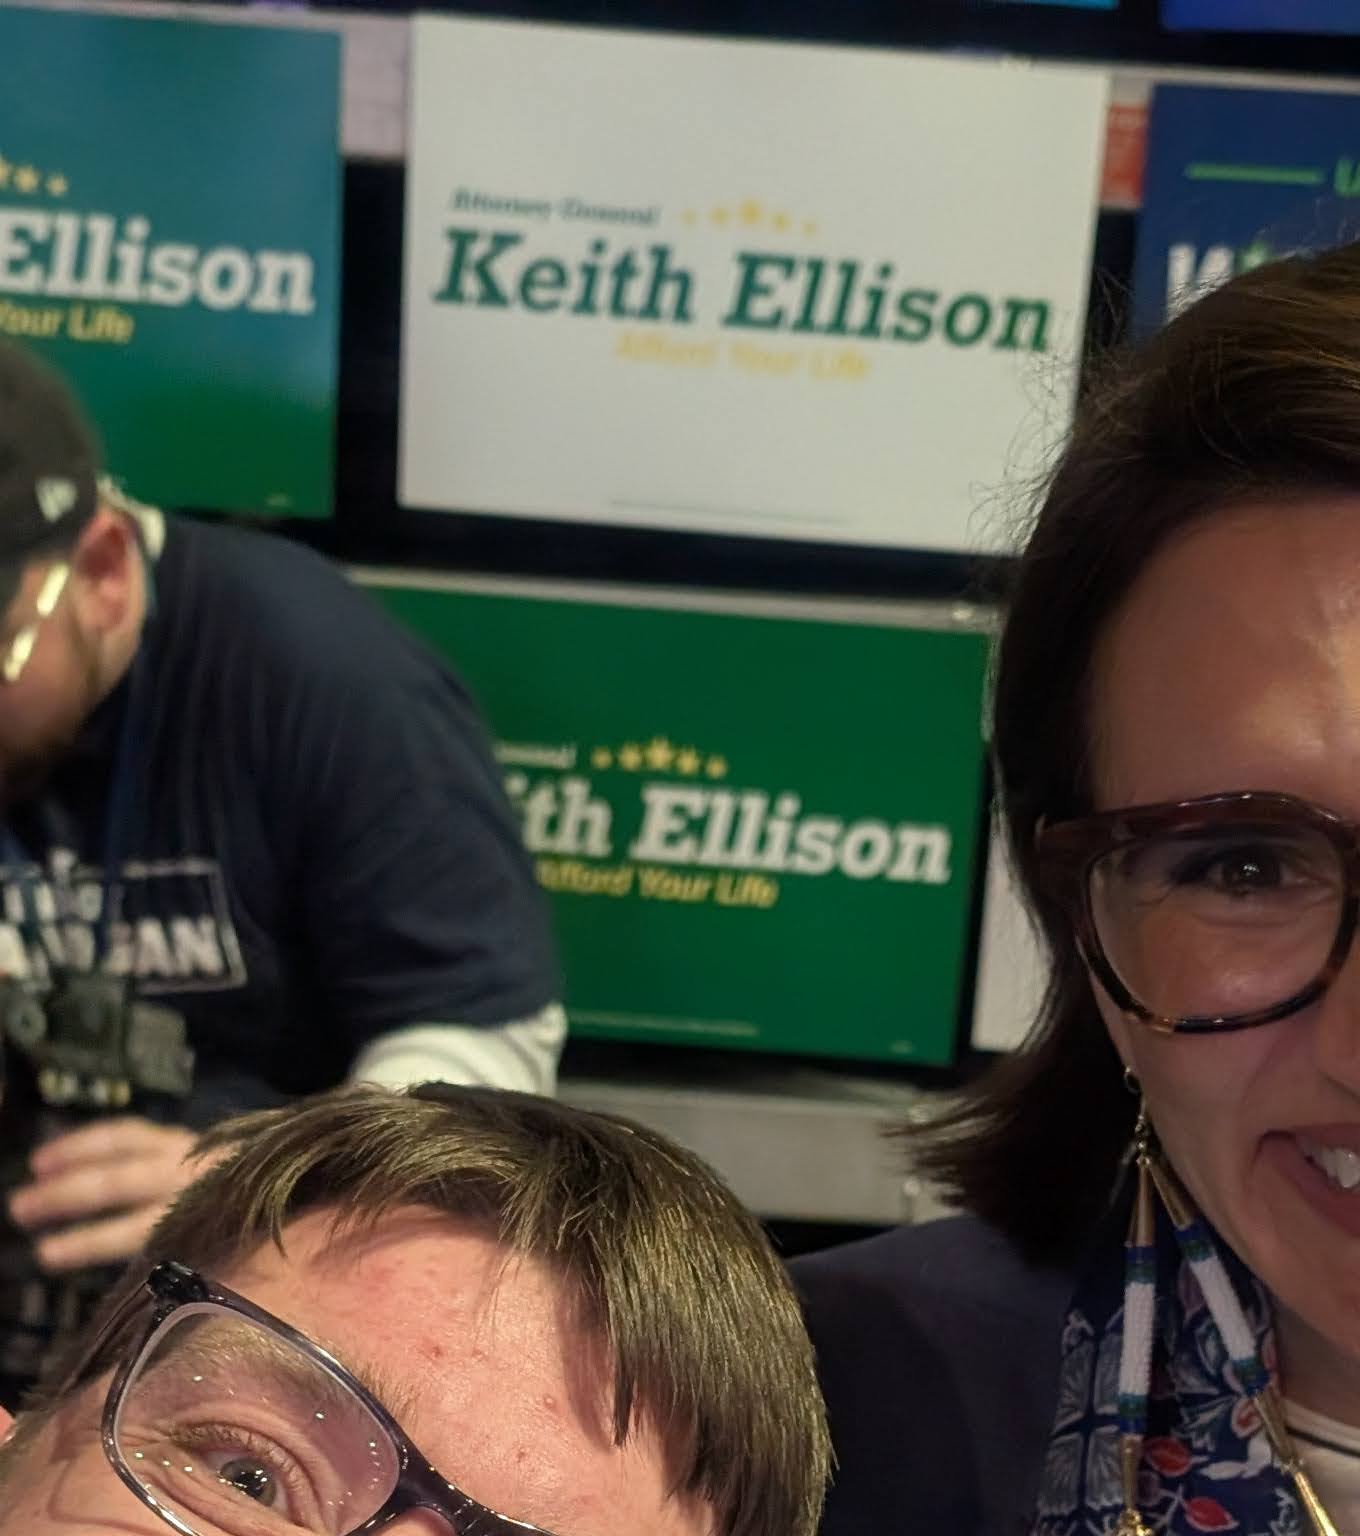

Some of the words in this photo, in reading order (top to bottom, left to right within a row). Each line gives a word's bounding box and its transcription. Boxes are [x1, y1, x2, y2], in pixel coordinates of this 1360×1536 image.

[67, 302, 135, 344] Life
[434, 228, 692, 326] Keith
[723, 250, 1054, 354] Ellison
[629, 782, 952, 884] Ellison
[638, 865, 714, 905] Your
[713, 872, 780, 910] Life
